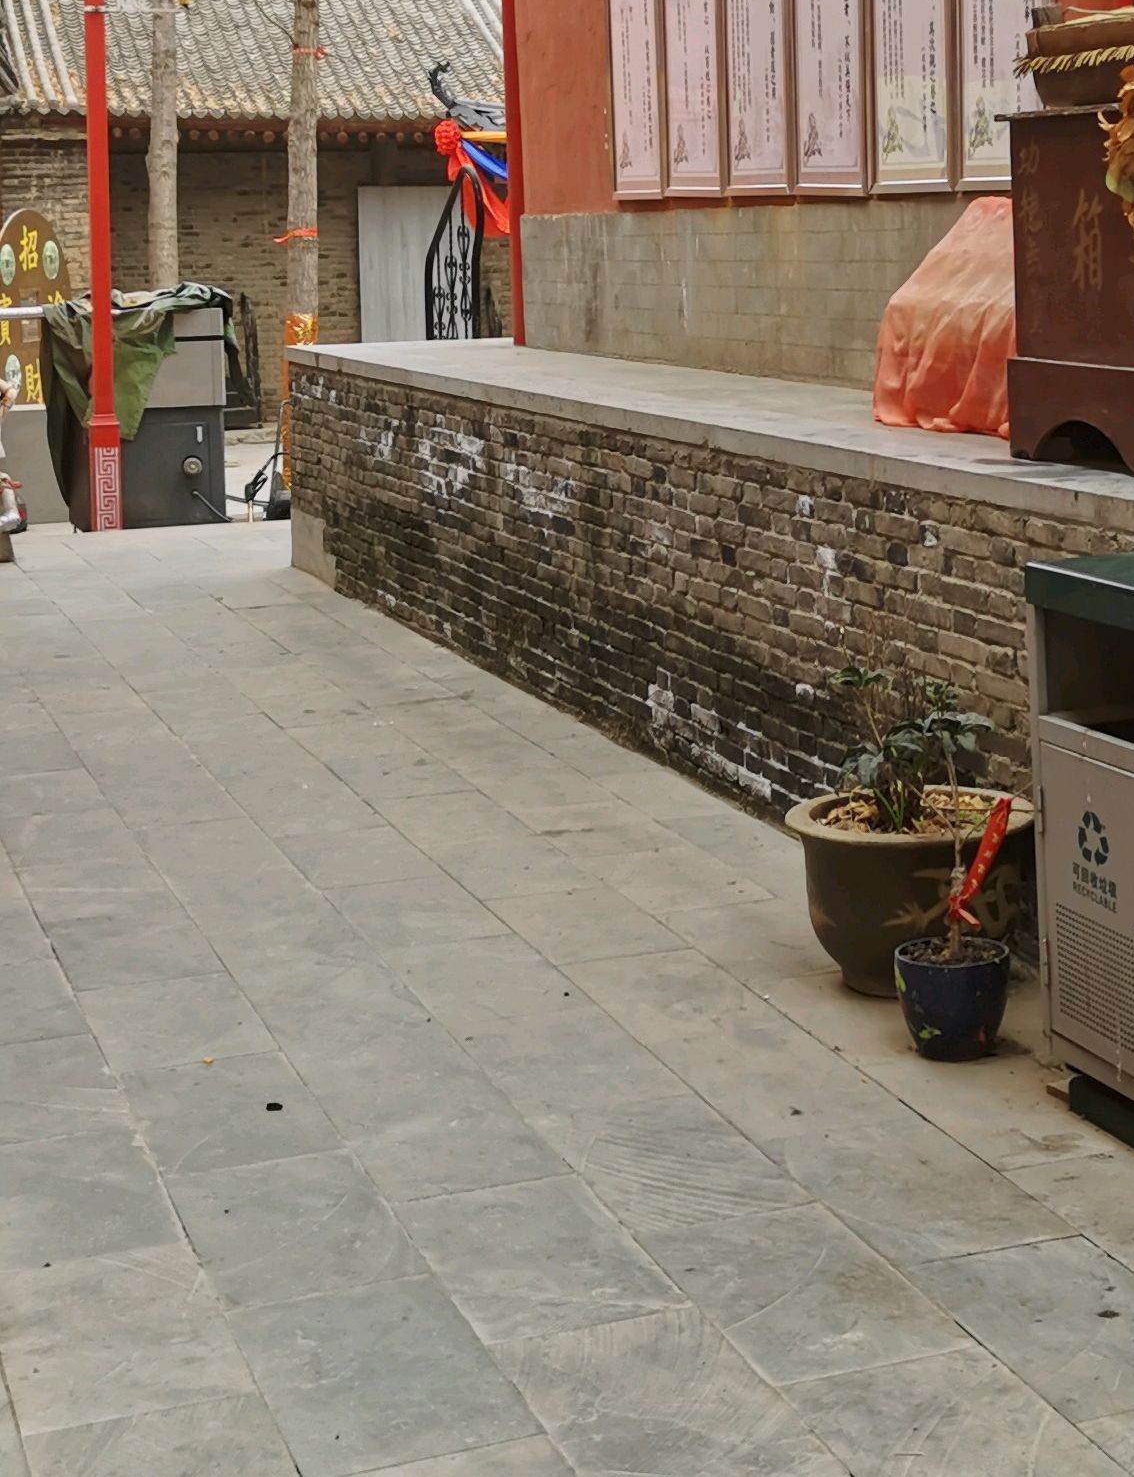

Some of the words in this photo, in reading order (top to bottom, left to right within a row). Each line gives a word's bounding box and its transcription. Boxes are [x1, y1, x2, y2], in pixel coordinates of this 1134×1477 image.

[19, 224, 39, 272] 招
[1072, 862, 1118, 899] 可回收垃圾
